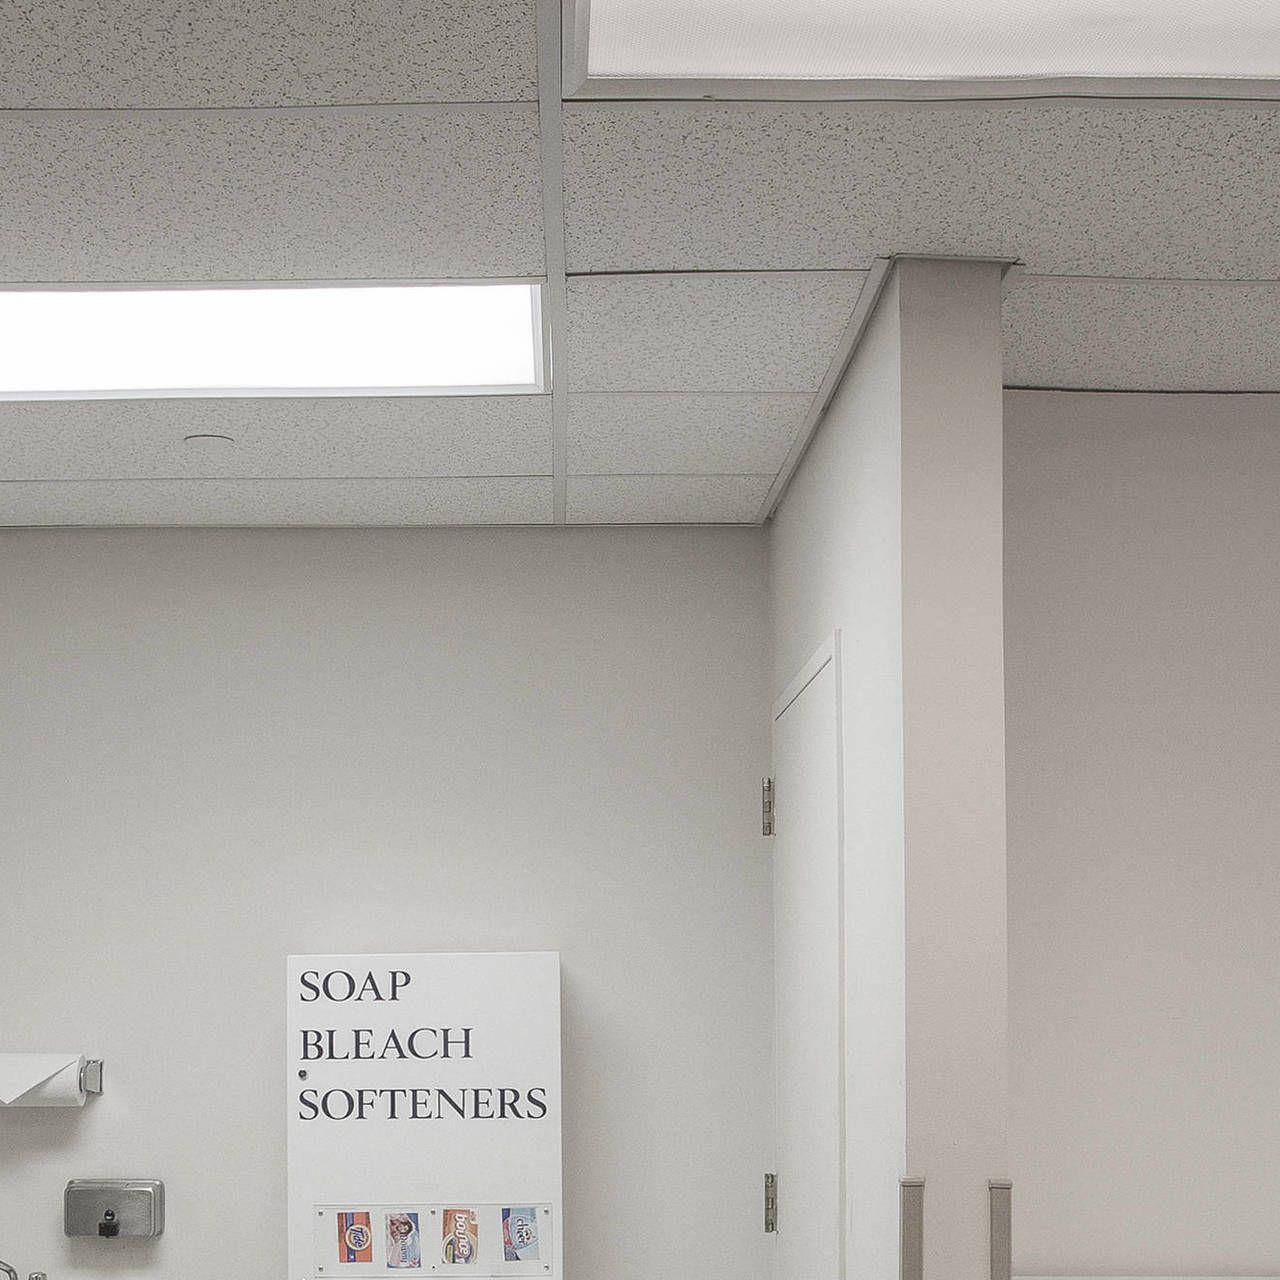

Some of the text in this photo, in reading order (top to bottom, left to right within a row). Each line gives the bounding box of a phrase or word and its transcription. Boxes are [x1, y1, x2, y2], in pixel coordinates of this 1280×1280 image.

[299, 970, 412, 1002] SOAP
[299, 1027, 474, 1060] BLEACH
[298, 1088, 548, 1120] SOFTENERS
[349, 1226, 364, 1248] Tide
[454, 1213, 470, 1257] bounce
[516, 1217, 530, 1245] cheer
